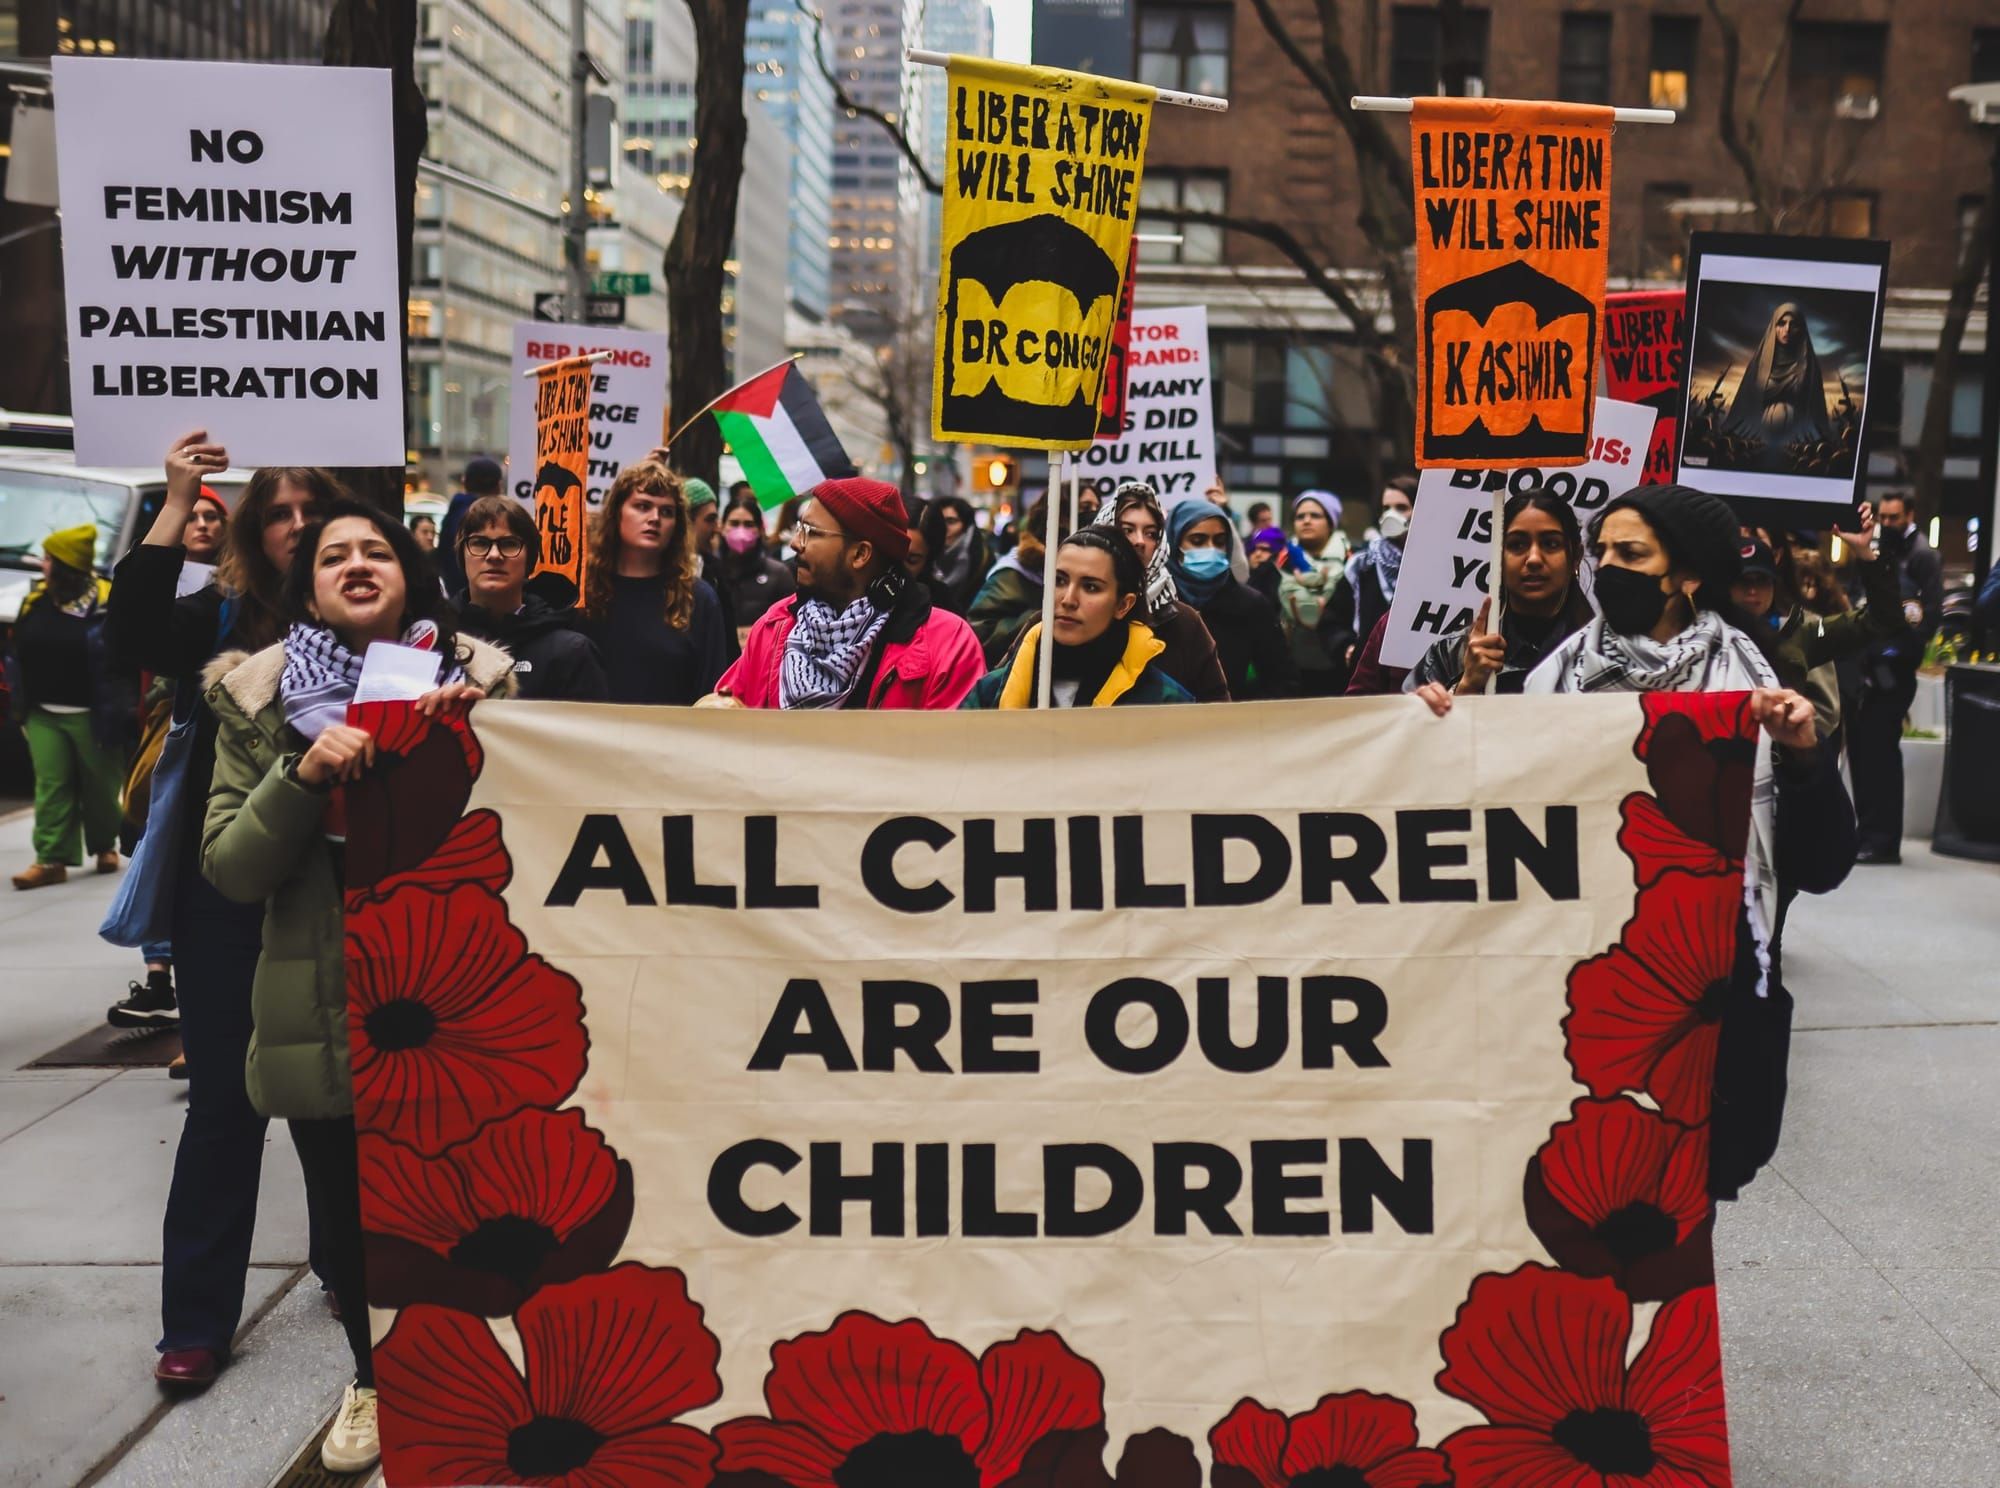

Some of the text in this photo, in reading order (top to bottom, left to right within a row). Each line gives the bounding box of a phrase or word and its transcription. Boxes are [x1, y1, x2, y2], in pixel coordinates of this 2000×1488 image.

[191, 130, 263, 163] NO
[956, 86, 1142, 161] LIBERATION
[958, 148, 1135, 220] WILL SHINE
[1420, 131, 1603, 192] LIBERATION
[104, 186, 351, 224] FEMINISM
[1425, 198, 1601, 250] WILL SHINE
[112, 246, 356, 283] WITHOUT
[80, 307, 384, 341] PALESTINIAN
[962, 319, 1102, 371] DR CONGO
[93, 365, 377, 399] LIBERATION
[1129, 378, 1204, 400] MANY
[1445, 338, 1573, 406] KASHMIR
[1144, 408, 1198, 430] DID
[1138, 439, 1202, 464] KILL
[545, 805, 1580, 914] ALL CHILDREN
[746, 975, 1391, 1074] ARE OUR
[707, 1137, 1434, 1238] CHILDREN
